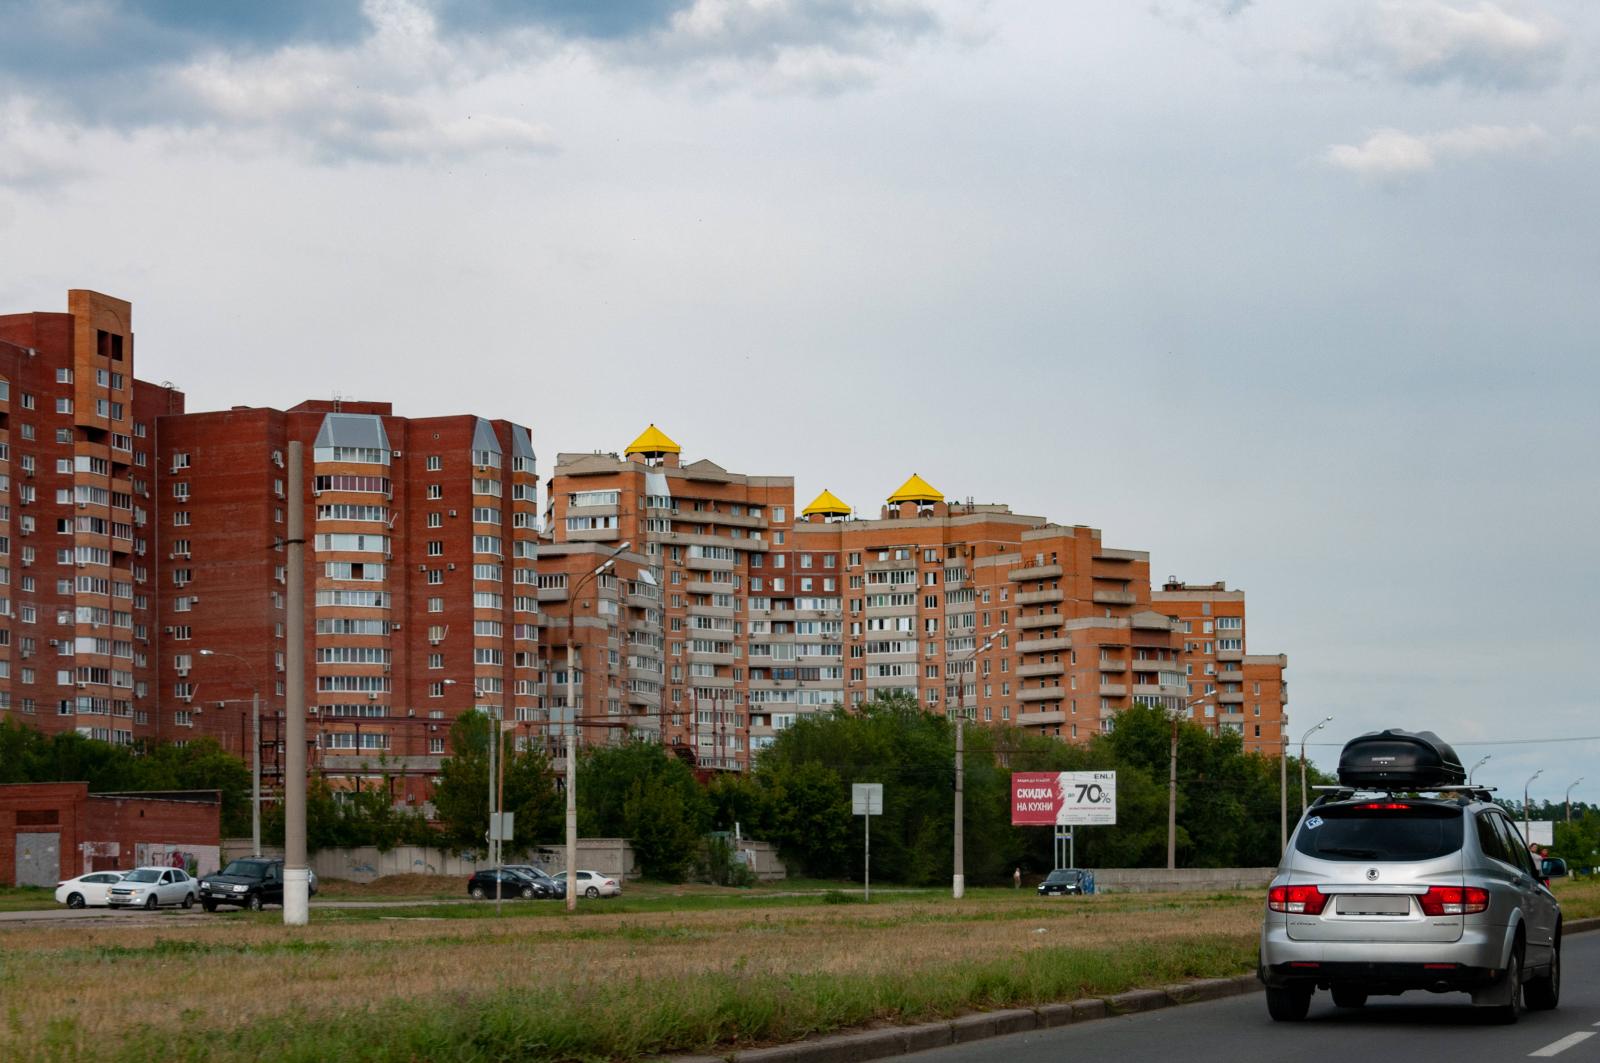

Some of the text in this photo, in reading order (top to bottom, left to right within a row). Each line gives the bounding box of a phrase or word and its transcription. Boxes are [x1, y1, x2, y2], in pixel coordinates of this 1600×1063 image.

[1017, 788, 1052, 799] СКИДКА
[1075, 784, 1111, 803] 70%
[1017, 802, 1053, 811] НА КУХНИ
